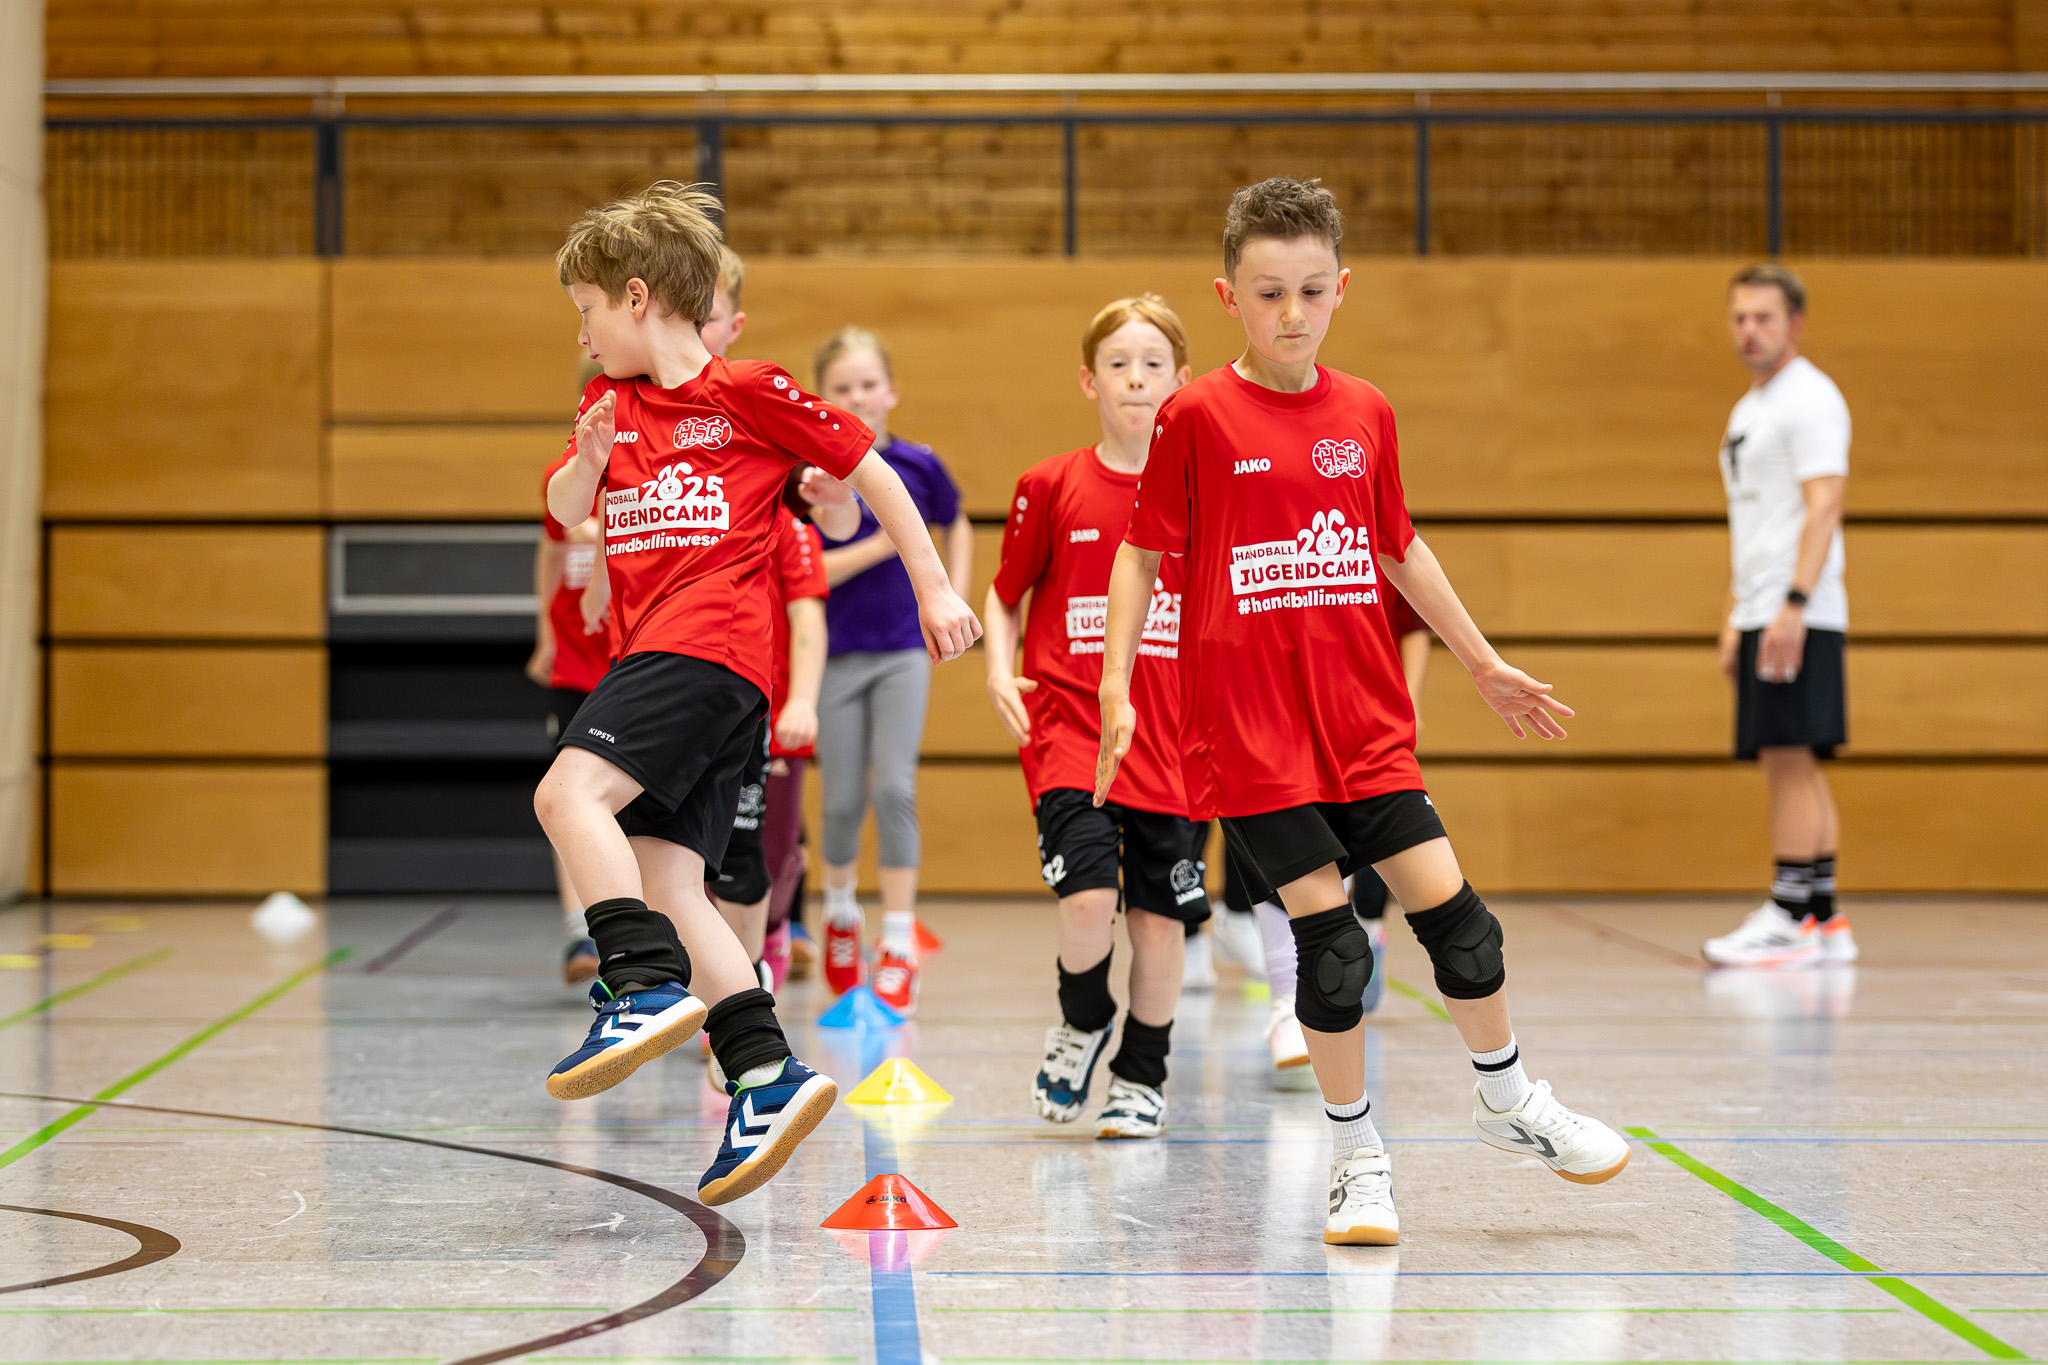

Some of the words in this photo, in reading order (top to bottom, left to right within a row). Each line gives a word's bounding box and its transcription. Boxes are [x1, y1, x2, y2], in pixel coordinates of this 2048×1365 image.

[613, 430, 639, 444] AKO
[1233, 457, 1271, 475] JAKO
[606, 492, 638, 506] NDBALL
[606, 505, 723, 530] UGENDCAMP
[1235, 545, 1295, 562] HANDBALL
[1240, 560, 1371, 587] JUGENDCAMP
[1238, 588, 1379, 616] #handballinwesel
[588, 727, 615, 744] KIPSTA
[880, 1194, 907, 1204] JAKO
